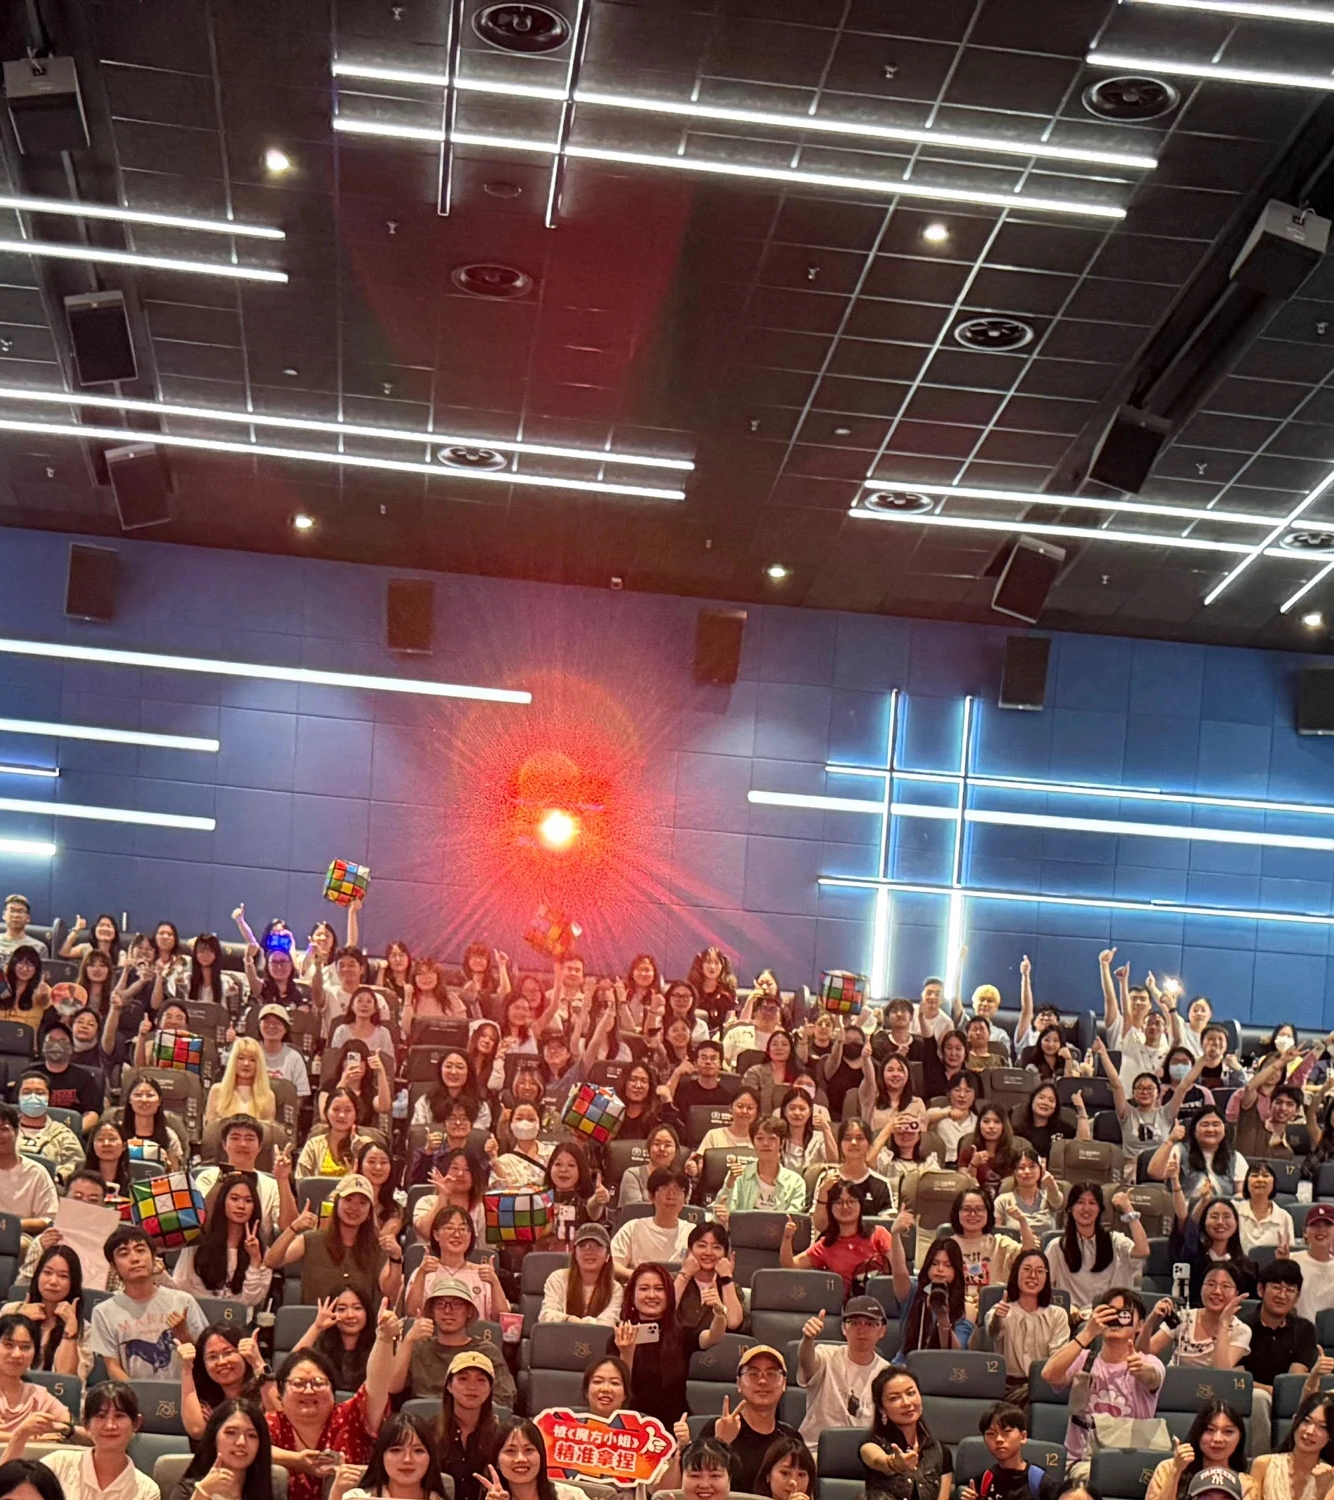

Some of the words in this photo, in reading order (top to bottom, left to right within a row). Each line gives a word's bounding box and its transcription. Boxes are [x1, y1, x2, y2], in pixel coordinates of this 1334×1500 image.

[17, 1029, 24, 1037] 3
[0, 1220, 6, 1230] 4
[826, 1280, 834, 1290] 11
[224, 1308, 233, 1320] 6
[484, 1329, 491, 1340] 8
[987, 1362, 998, 1372] 12
[55, 1383, 63, 1395] 5
[1234, 1378, 1245, 1390] 14
[554, 1442, 637, 1471] 精准拿捏
[1045, 1454, 1058, 1466] 12
